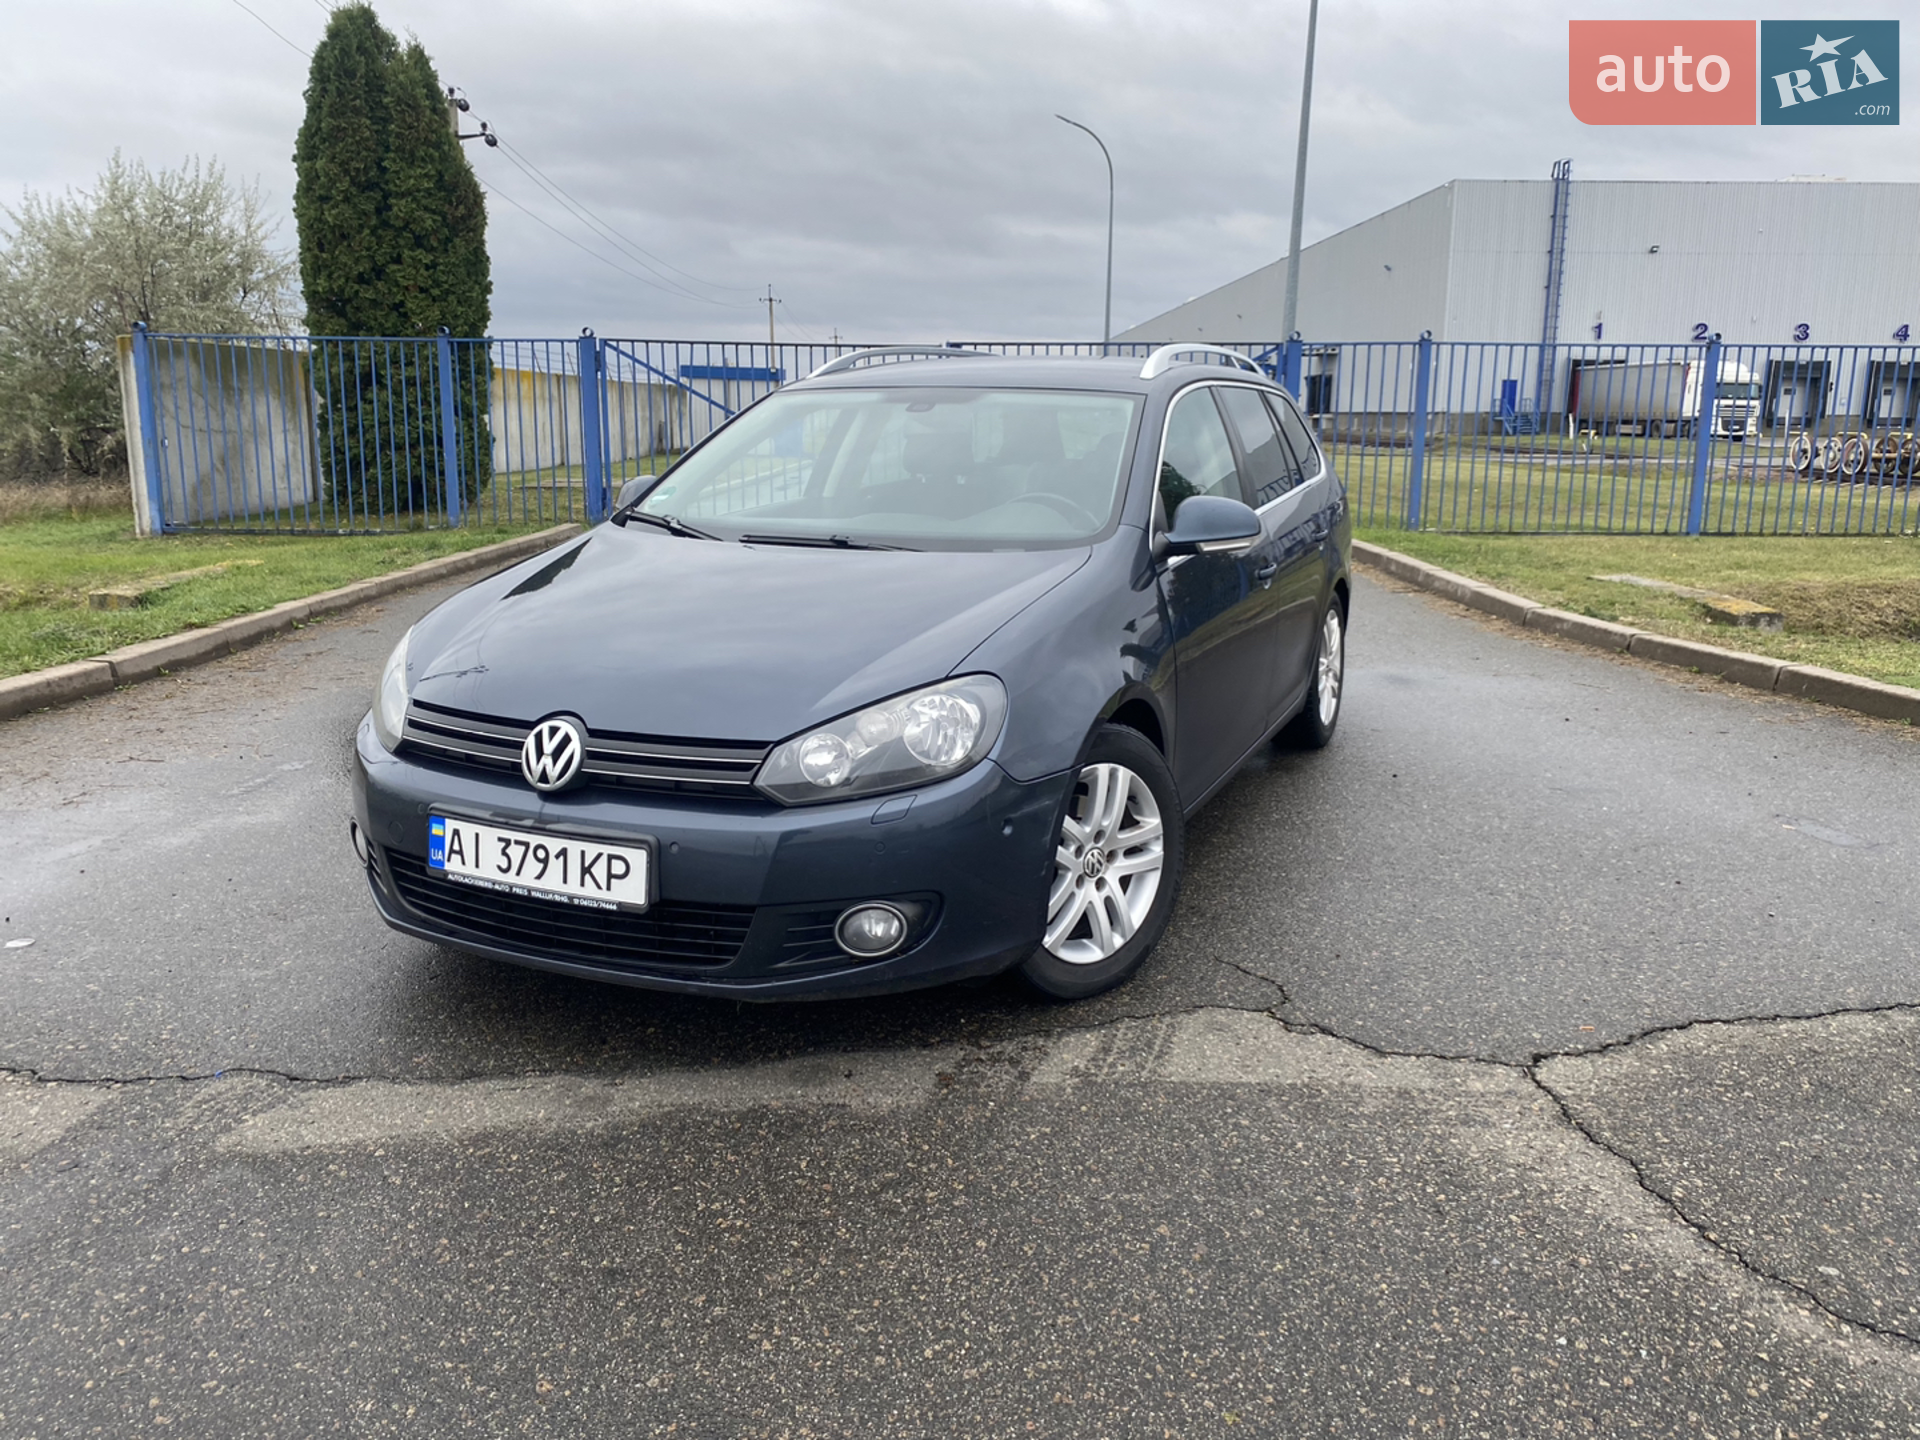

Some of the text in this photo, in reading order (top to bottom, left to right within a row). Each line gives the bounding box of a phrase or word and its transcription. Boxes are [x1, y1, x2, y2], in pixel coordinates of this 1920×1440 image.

[1593, 322, 1603, 341] 1
[1693, 322, 1708, 342] 2
[1794, 323, 1810, 342] 3
[1893, 323, 1910, 343] 4
[431, 847, 444, 862] UA
[446, 827, 631, 892] AI 3791 KP
